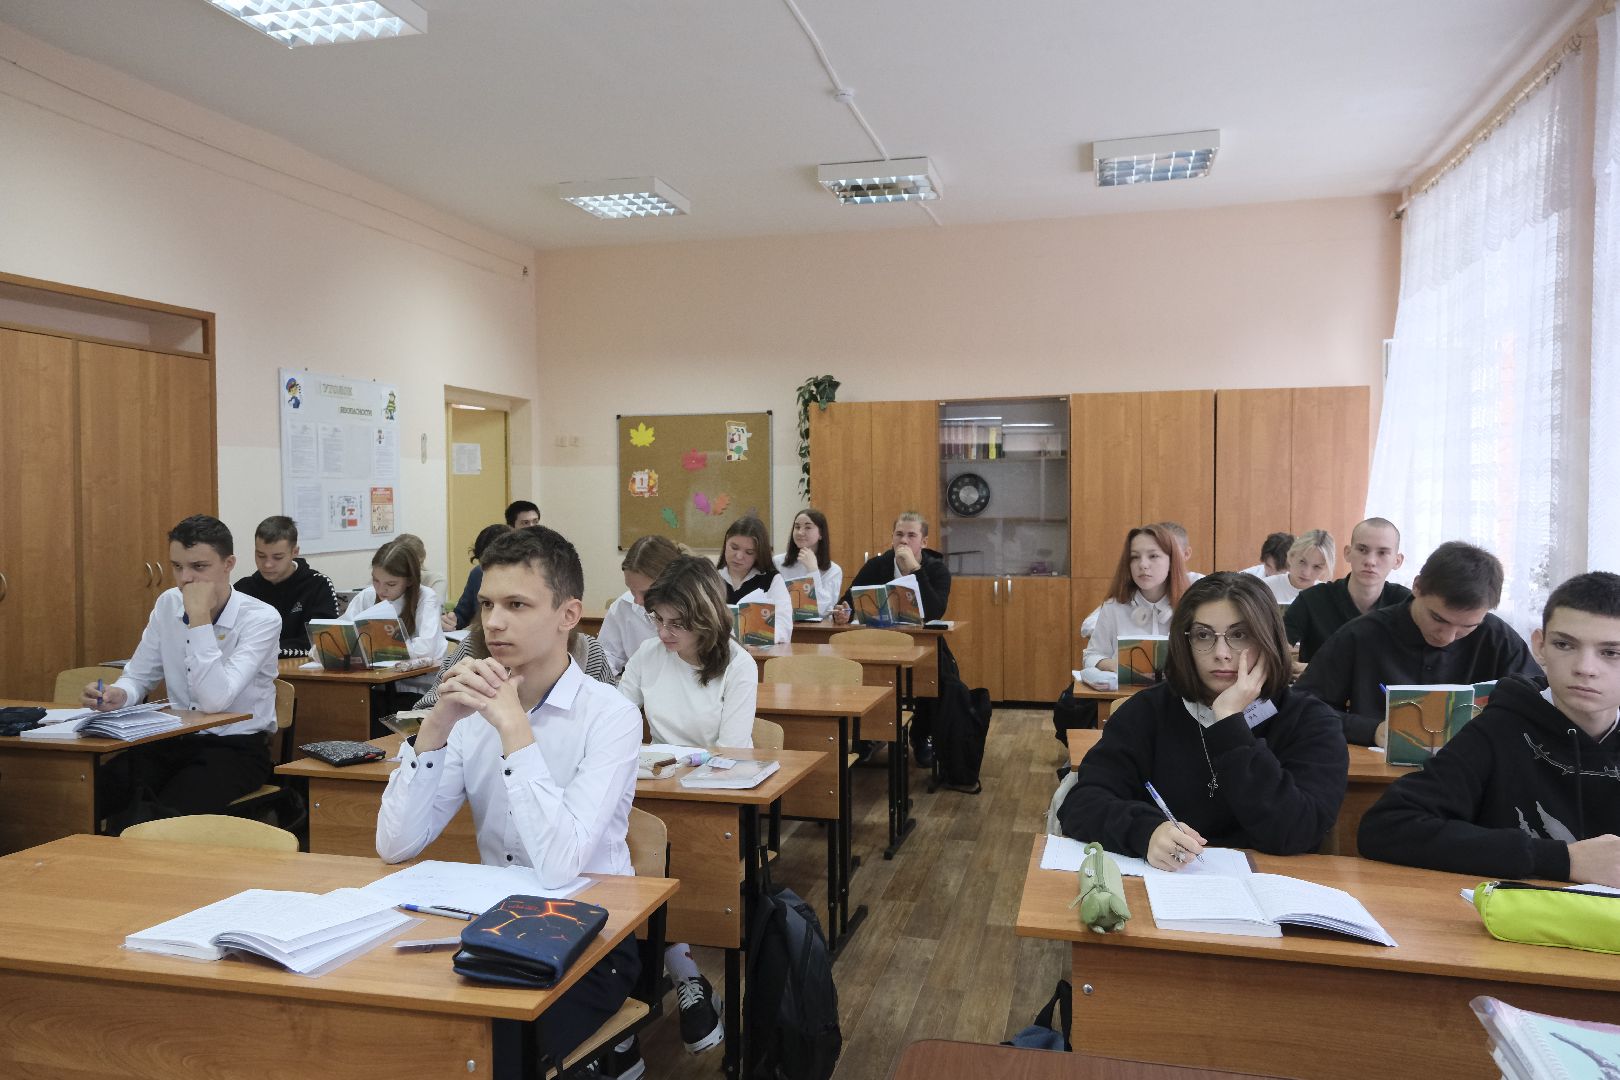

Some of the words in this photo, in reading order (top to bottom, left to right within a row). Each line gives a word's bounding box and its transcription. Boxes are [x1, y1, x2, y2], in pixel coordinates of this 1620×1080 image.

[803, 583, 811, 593] 9
[760, 608, 771, 620] 9
[384, 624, 395, 636] 9
